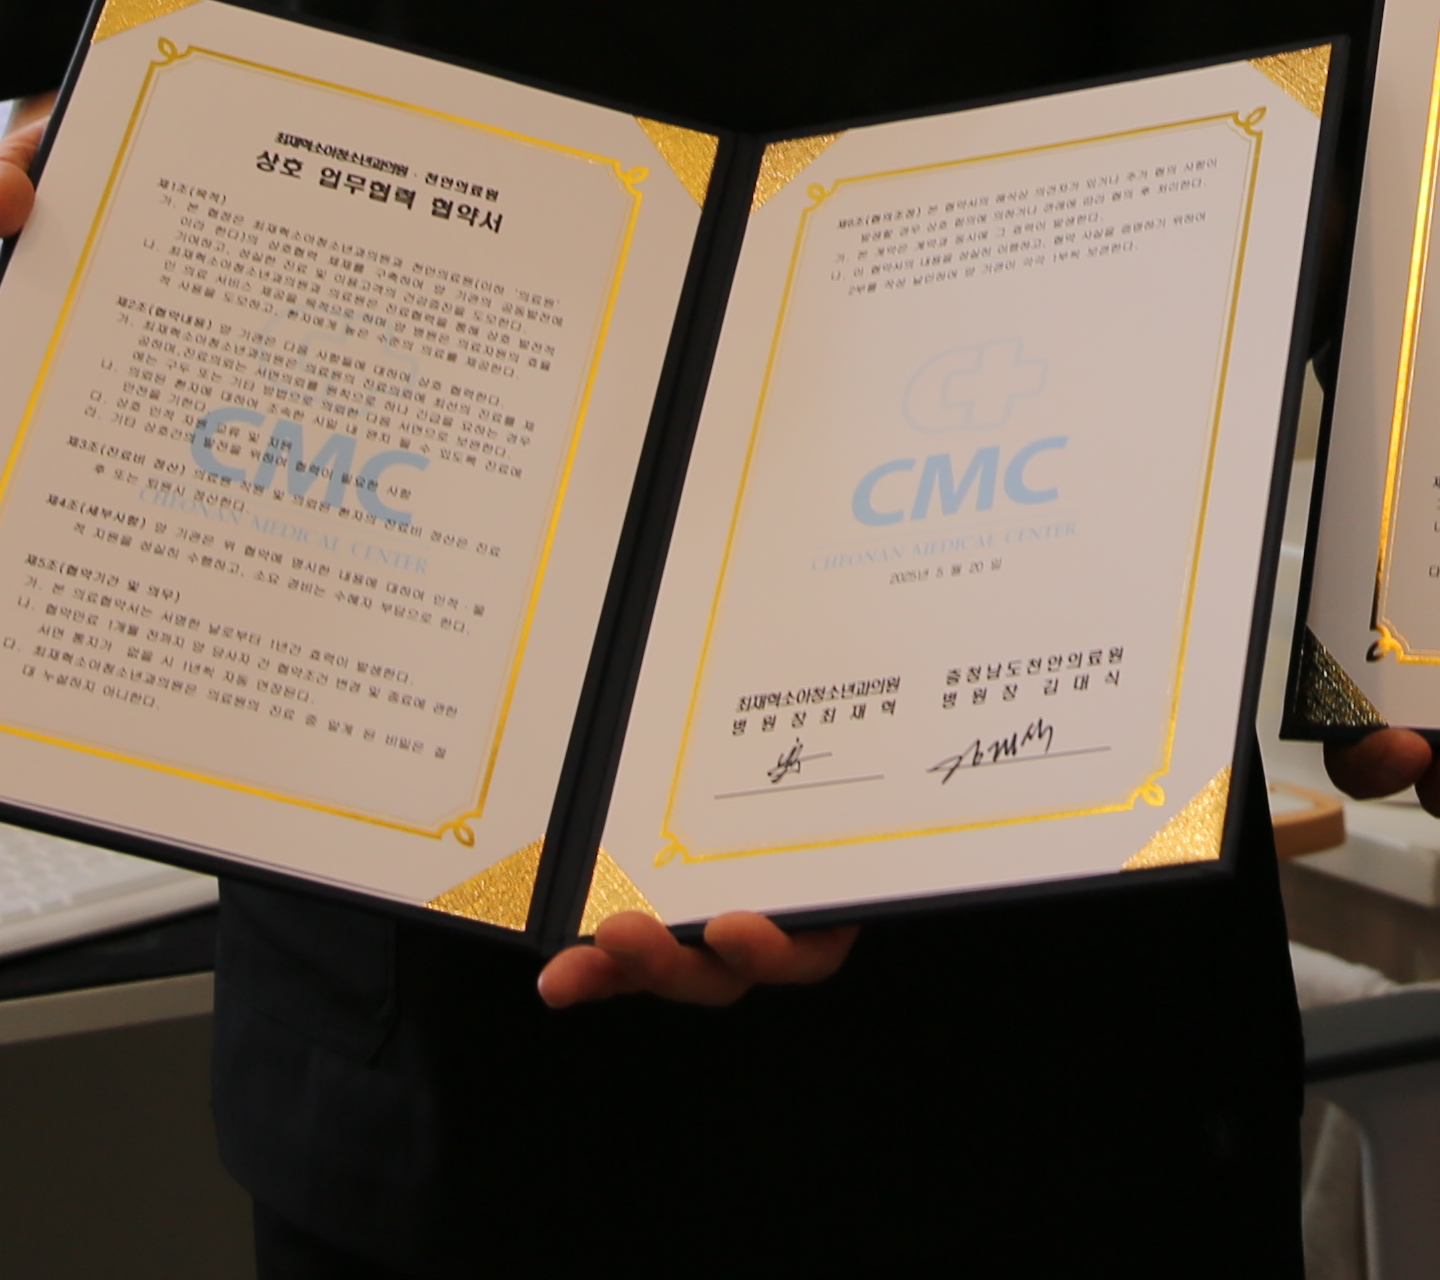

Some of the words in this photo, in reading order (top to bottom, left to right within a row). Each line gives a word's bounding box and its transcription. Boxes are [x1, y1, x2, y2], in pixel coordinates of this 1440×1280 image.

[254, 148, 305, 180] 상호
[317, 165, 416, 211] 업무협력
[429, 195, 504, 235] 협약서
[273, 130, 410, 179] 최재혁소아청소년과의원
[423, 170, 499, 203] 천안의료원
[190, 406, 430, 527] CMC
[852, 435, 1069, 526] CMC
[735, 675, 901, 712] 최재혁소아청소년과의원
[945, 645, 1124, 686] 충청남도천안의료원
